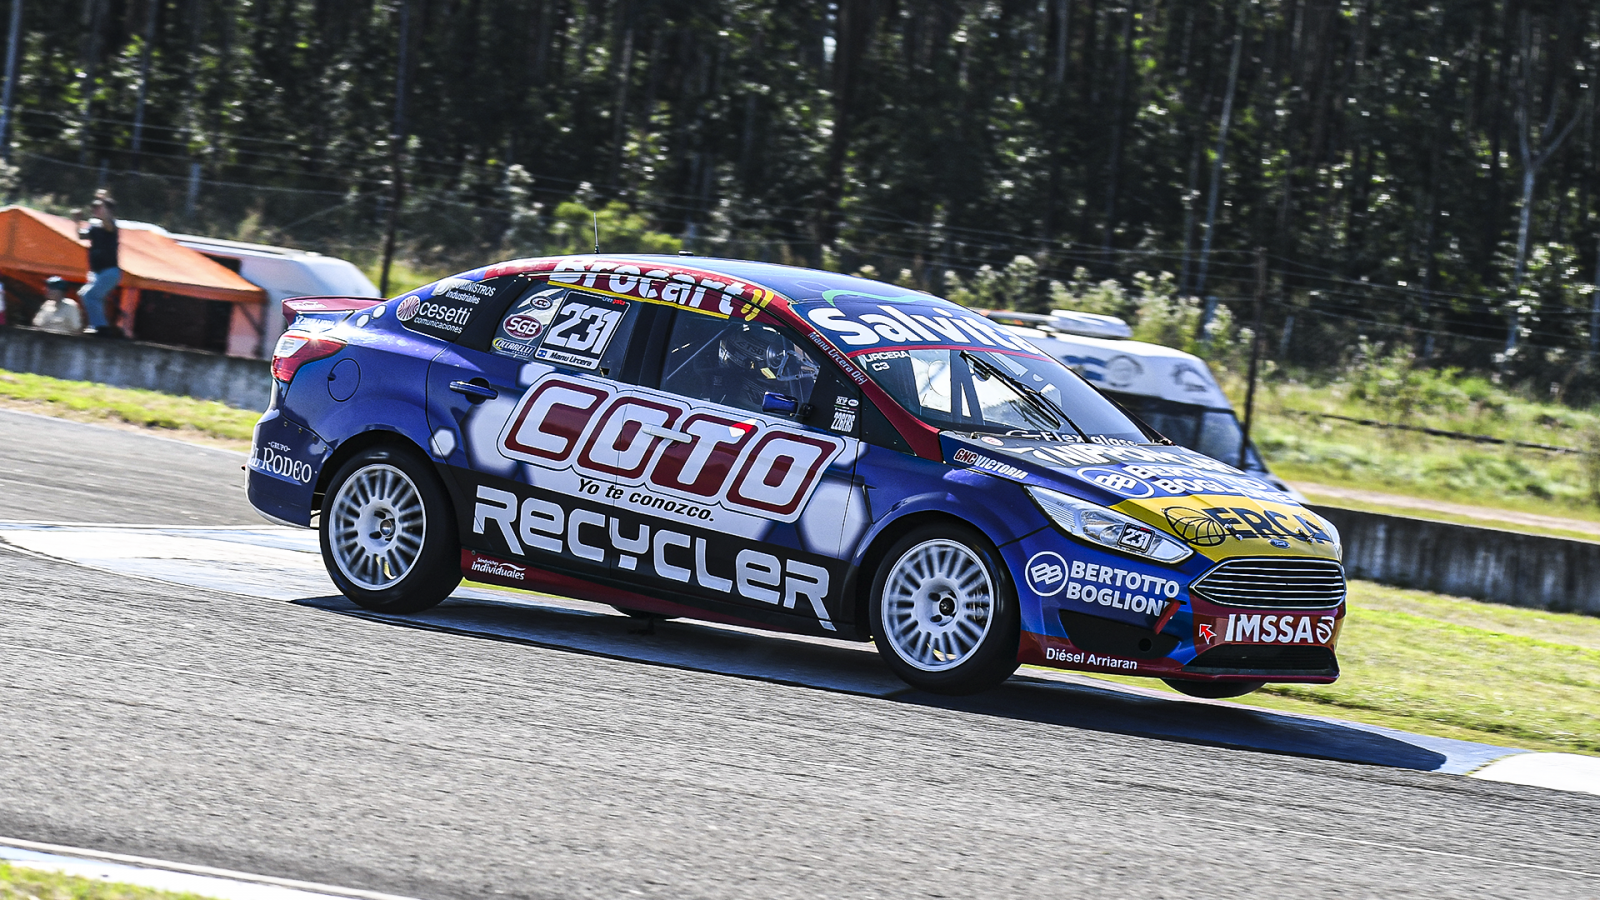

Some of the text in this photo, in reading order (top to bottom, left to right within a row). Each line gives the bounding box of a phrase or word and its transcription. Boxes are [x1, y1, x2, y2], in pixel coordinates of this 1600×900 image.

[549, 257, 748, 316] Brocart
[413, 316, 463, 334] comunicaciones
[419, 300, 473, 326] cesetti
[506, 317, 540, 336] SGB
[544, 302, 623, 355] 231
[807, 304, 1040, 354] Salvita
[549, 351, 593, 367] Manu Urcera
[808, 331, 830, 352] Manu
[828, 348, 853, 373] Urcera
[861, 350, 911, 363] URCERA
[871, 361, 891, 372] C3
[504, 379, 837, 516] COTO
[954, 447, 1029, 480] GNC VICTORIA
[260, 447, 312, 484] RODEO
[577, 478, 716, 523] Yo te conozco.
[1120, 527, 1152, 550] 231
[1070, 560, 1180, 598] BERTOTTO
[1066, 581, 1172, 618] BOGLION
[1224, 613, 1314, 644] IMSSA
[1045, 647, 1138, 671] Diésel Arriaran
